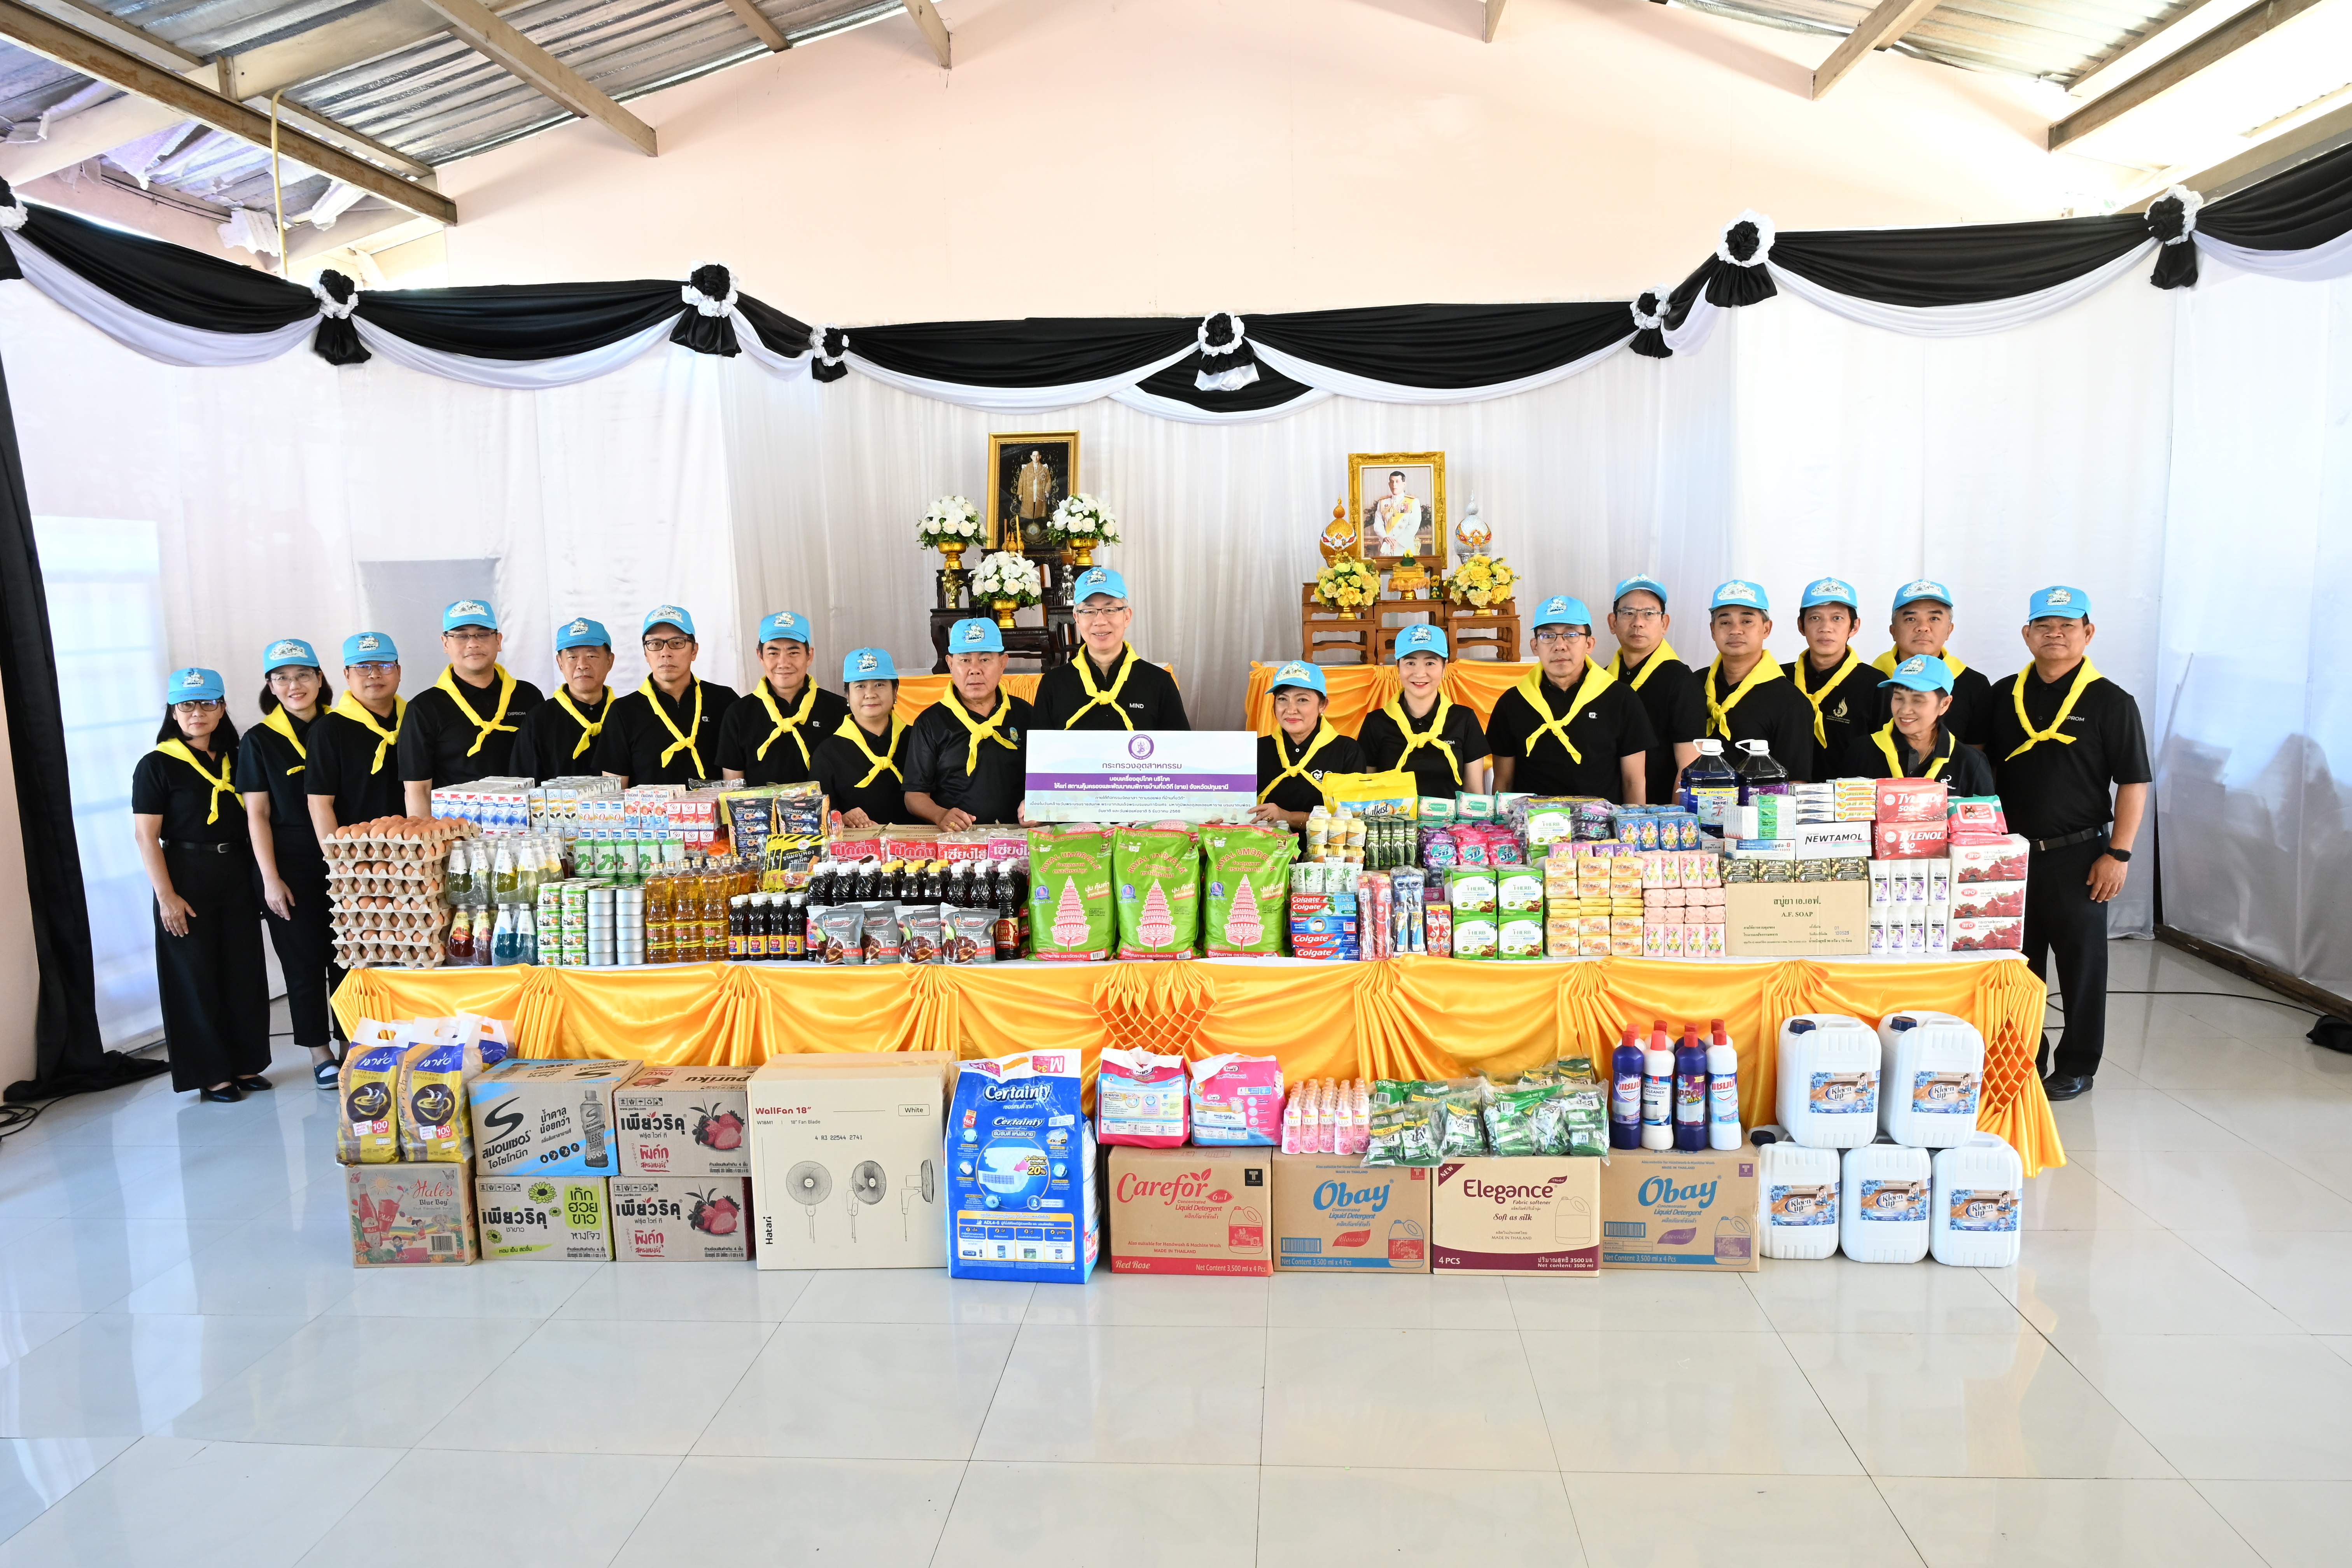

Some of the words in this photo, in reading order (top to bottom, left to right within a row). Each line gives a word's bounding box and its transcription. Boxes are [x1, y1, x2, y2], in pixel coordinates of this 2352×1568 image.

[1102, 763, 1182, 771] กระทรวงอุตสาหกรรม
[1110, 774, 1152, 782] มอบเครื่องอุปโภค
[1898, 793, 1942, 805] TYLENOL
[1805, 833, 1863, 845] NEWTAMOL
[1899, 831, 1942, 842] TYLENOL
[1039, 854, 1060, 873] ROYAL
[1061, 851, 1101, 871] UMBRELLA
[1127, 856, 1149, 873] ROYAL
[1215, 851, 1236, 871] ROYAL
[1236, 848, 1276, 872] UMBRELLA
[1773, 896, 1793, 907] สบู่ยา
[1796, 895, 1821, 905] เอ.เอฟ.
[1294, 935, 1330, 943] Colgate
[1297, 949, 1333, 957] Colgate
[1712, 1077, 1735, 1090] แชมป์
[1934, 1085, 1954, 1094] Kleen
[985, 1083, 1052, 1102] Certainty
[1831, 1086, 1852, 1095] Kleen
[1686, 1095, 1703, 1104] MAX
[541, 1107, 567, 1123] น้ำตาล
[755, 1107, 793, 1115] WallFan
[373, 1121, 388, 1129] 100
[540, 1116, 570, 1134] น้อยกว่า
[621, 1112, 685, 1135] เพียวริคุ
[993, 1116, 1044, 1127] Certainty
[437, 1125, 451, 1135] 100
[482, 1129, 531, 1159] สปอนเซอร์
[588, 1132, 602, 1144] LESS
[589, 1142, 602, 1150] SUGAR
[488, 1148, 528, 1169] ไอโซโทนิก
[1027, 1166, 1046, 1176] 20%
[1440, 1165, 1454, 1178] NEW
[410, 1178, 453, 1199] Hale's
[570, 1187, 593, 1201] เก๊ก
[1116, 1172, 1208, 1206] Carefor
[1464, 1179, 1553, 1204] Elegance
[1638, 1175, 1718, 1209] Obay
[1313, 1179, 1390, 1213] Obay
[568, 1202, 598, 1213] ฮวย
[1791, 1198, 1811, 1207] Kleen
[616, 1199, 681, 1220] เพียวริคุ
[482, 1206, 548, 1229] เพียวริคุ
[572, 1214, 597, 1225] ขาว
[1493, 1213, 1508, 1222] Soft
[1519, 1213, 1533, 1221] silk
[570, 1231, 600, 1240] หางโจว
[1115, 1260, 1132, 1269] Red
[1132, 1260, 1151, 1269] Rose
